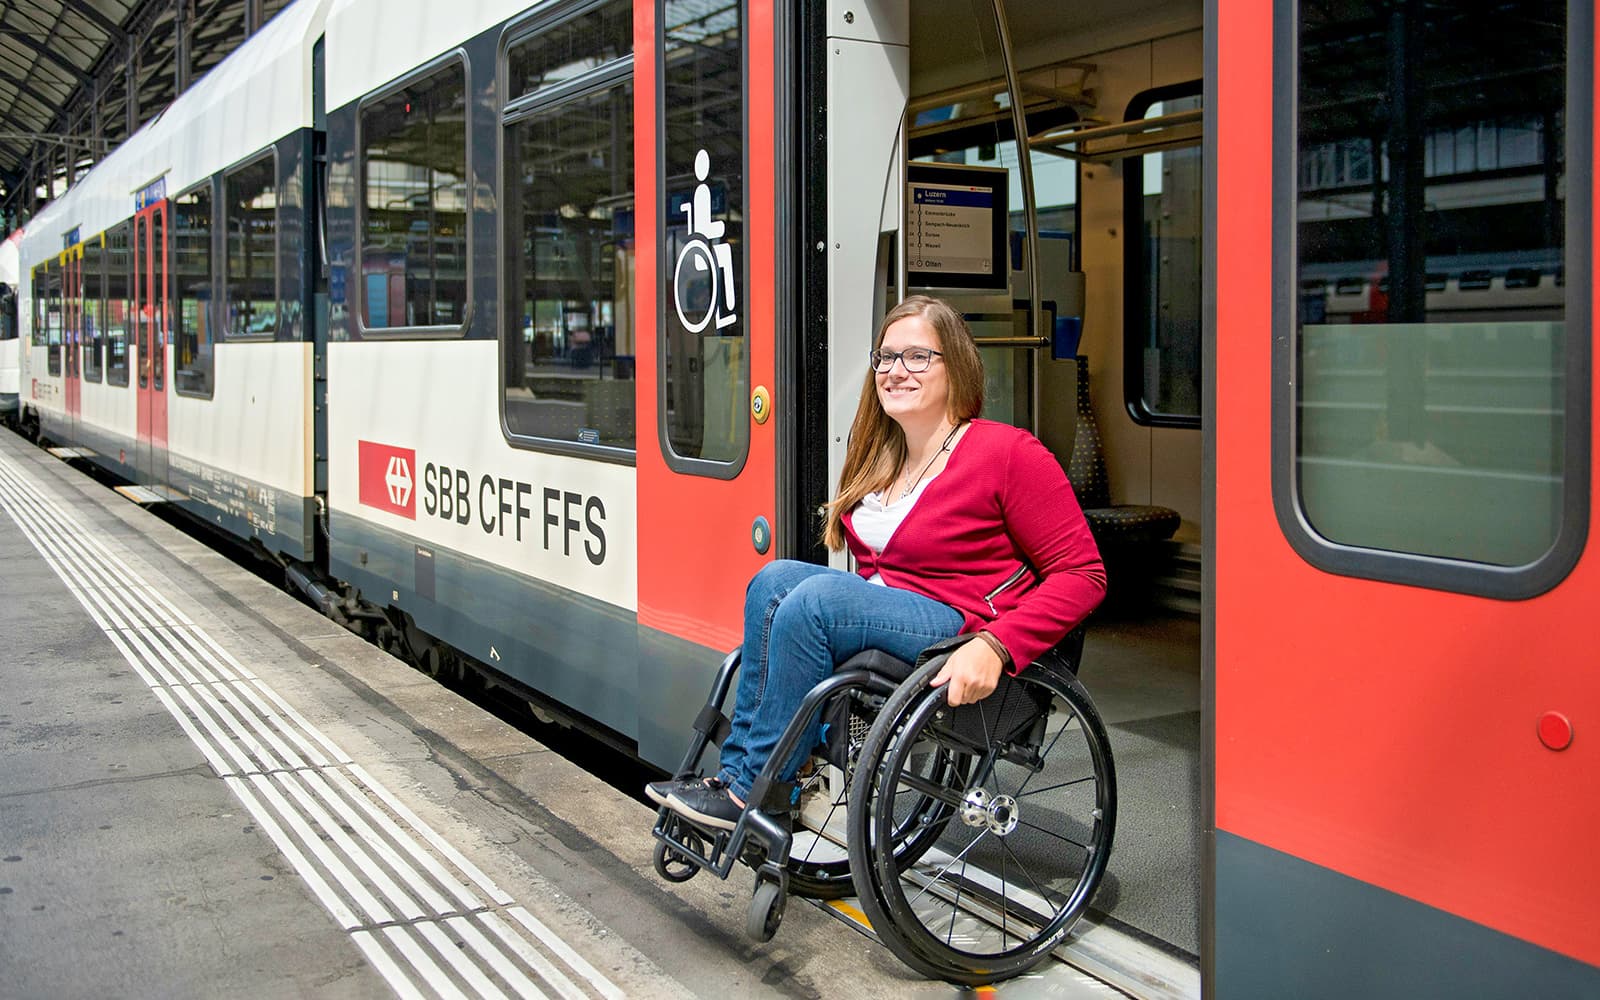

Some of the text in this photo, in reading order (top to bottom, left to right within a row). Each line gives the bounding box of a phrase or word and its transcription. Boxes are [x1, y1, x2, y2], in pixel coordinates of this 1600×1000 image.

[925, 190, 947, 199] Luzern
[424, 462, 607, 566] SBB CFF FFS
